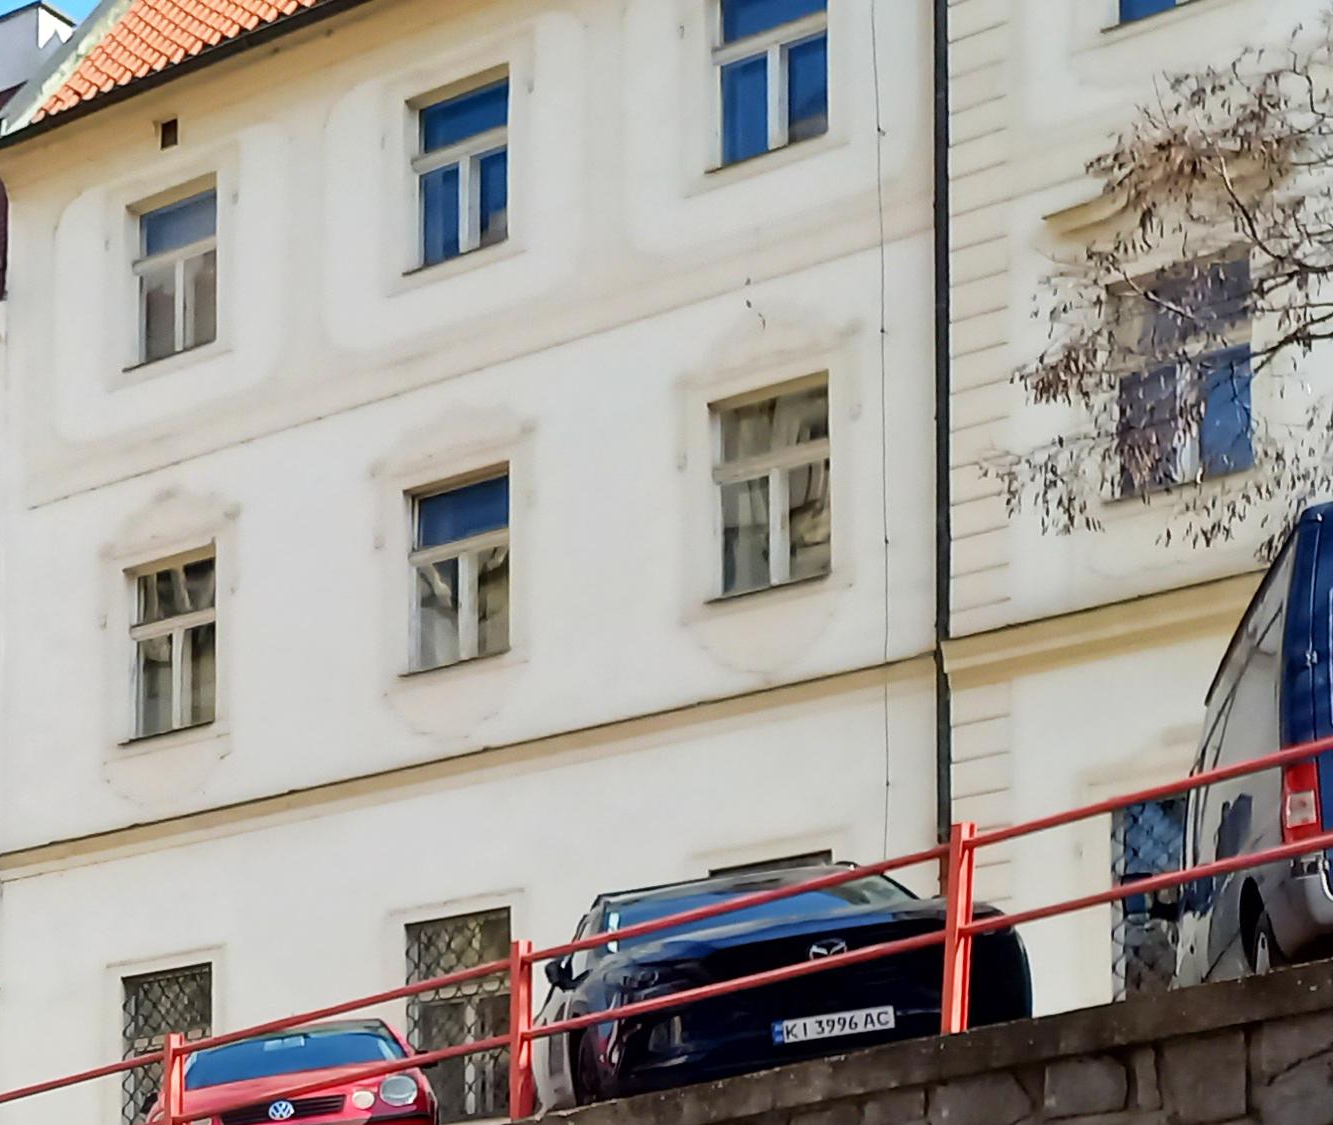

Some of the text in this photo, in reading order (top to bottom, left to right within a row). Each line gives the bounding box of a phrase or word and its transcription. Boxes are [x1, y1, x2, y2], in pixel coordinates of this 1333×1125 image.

[785, 1011, 890, 1040] KI 3996 AC
